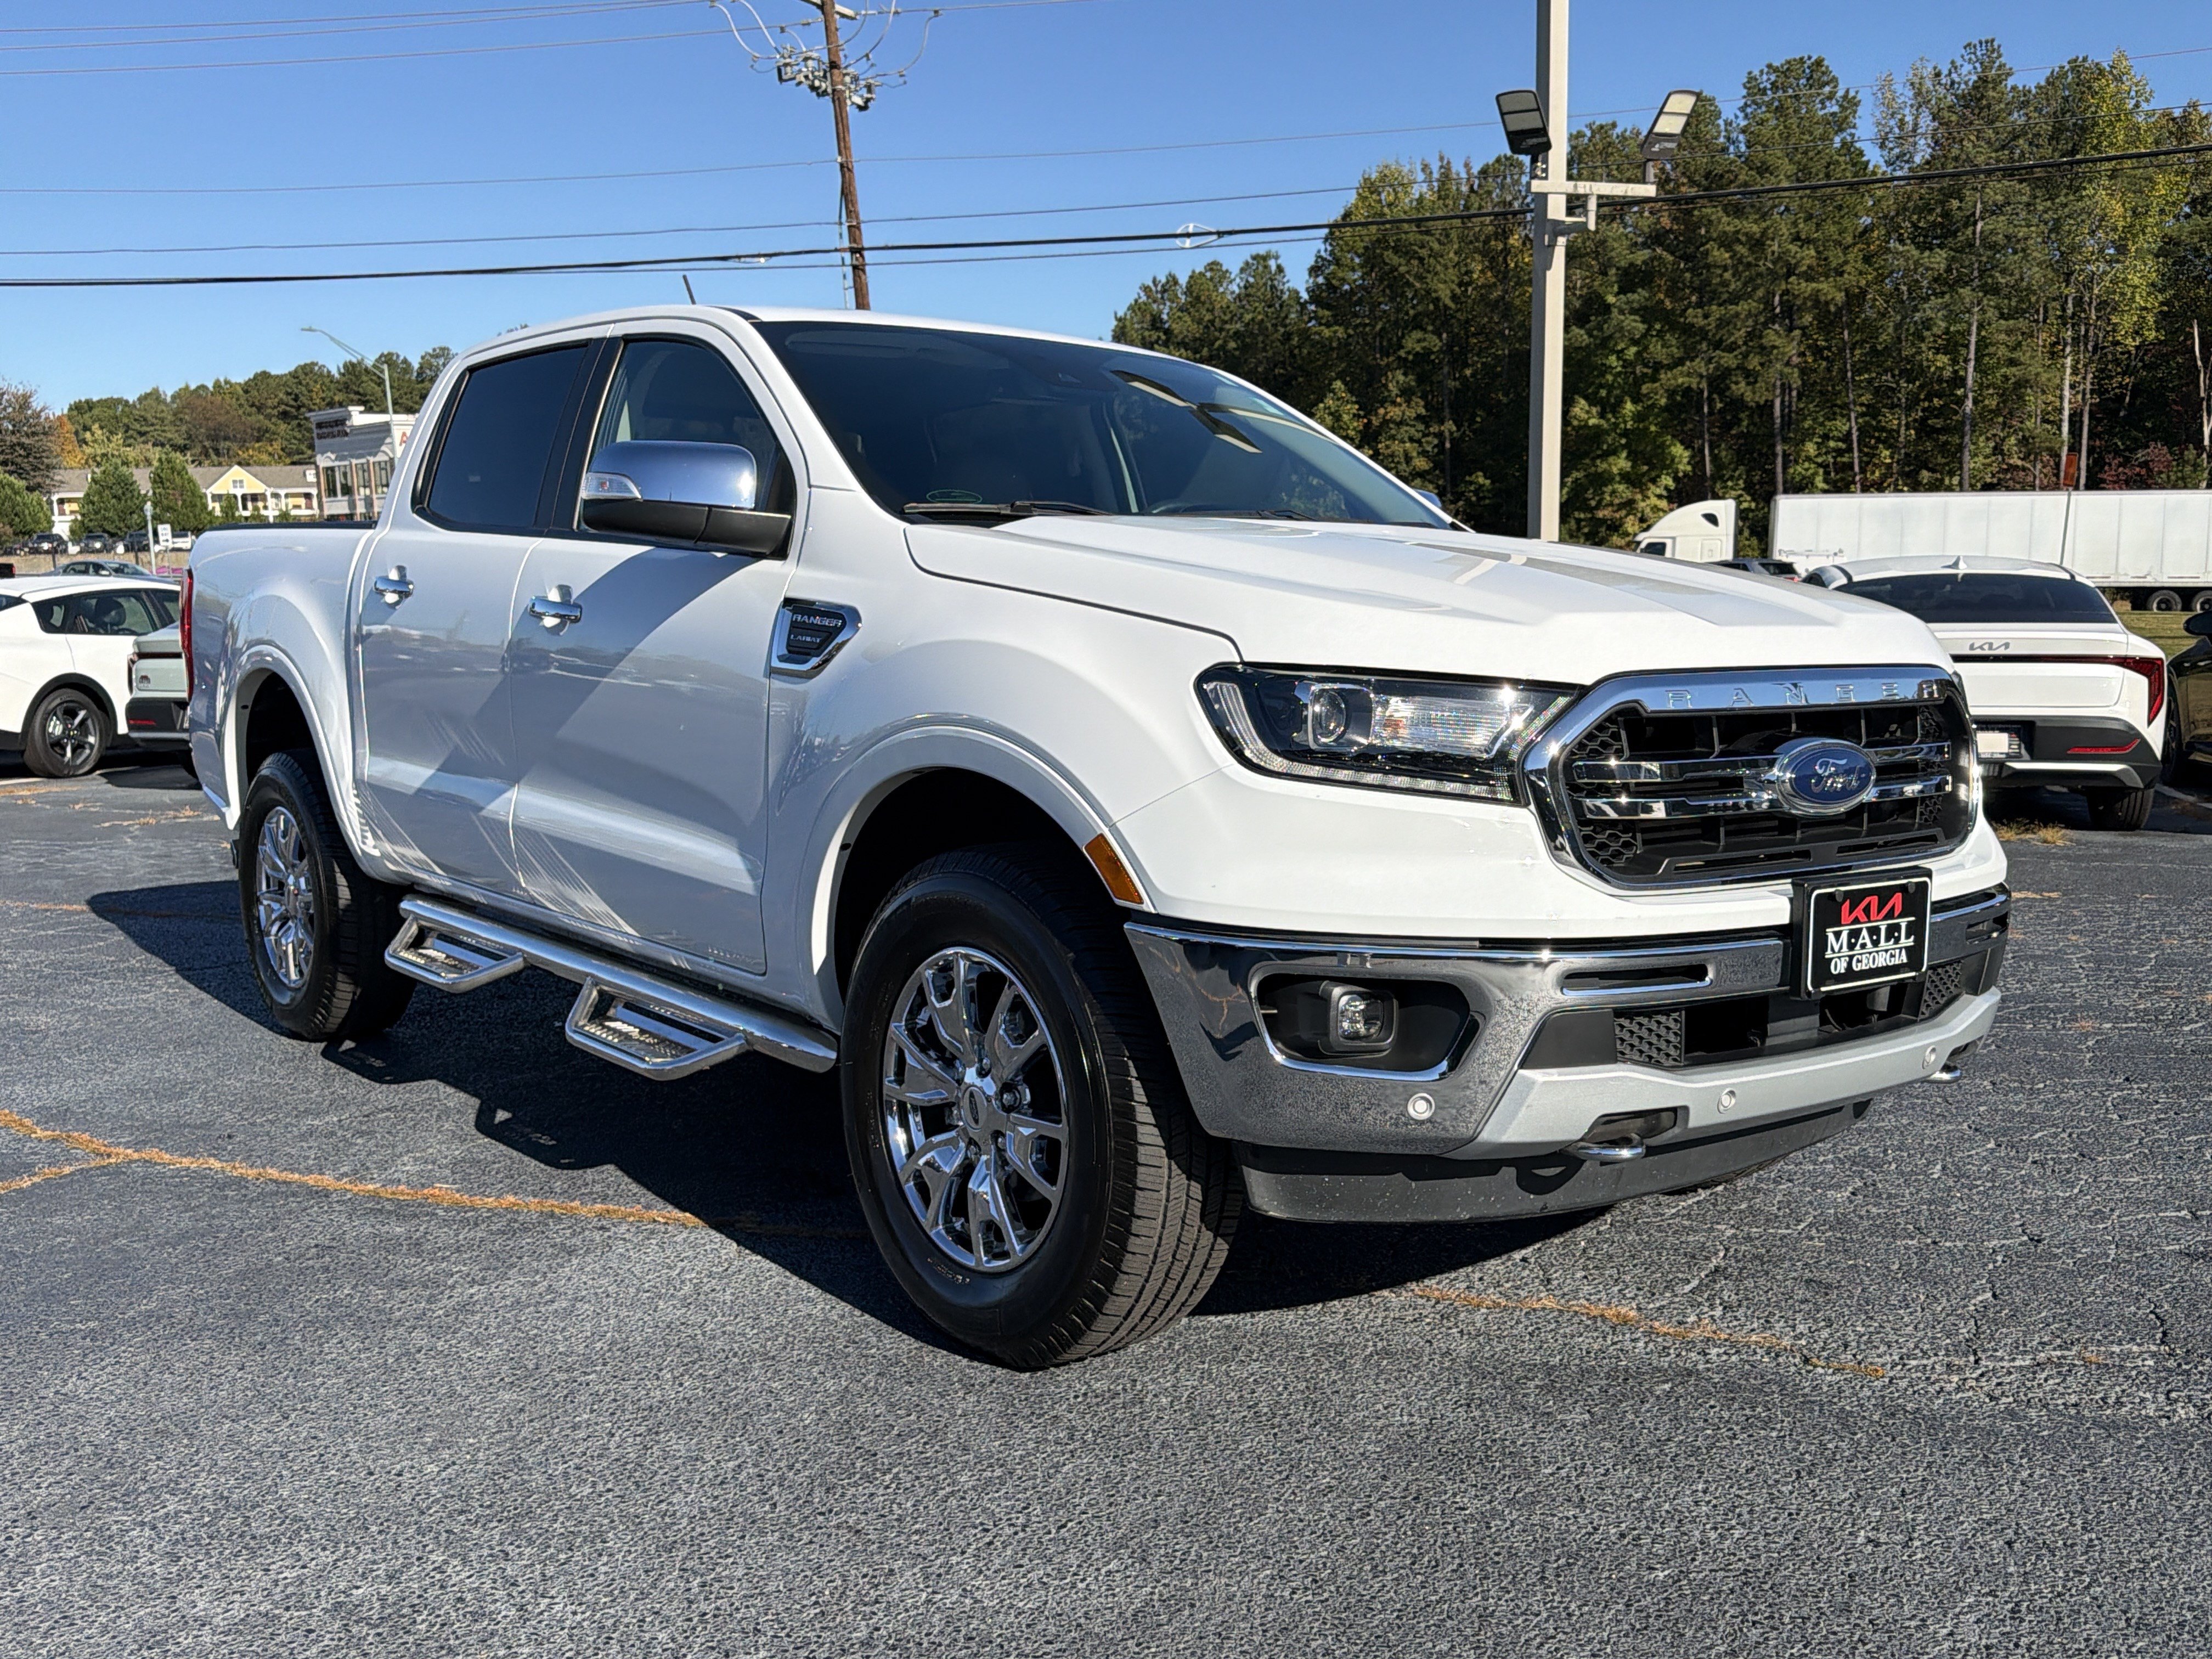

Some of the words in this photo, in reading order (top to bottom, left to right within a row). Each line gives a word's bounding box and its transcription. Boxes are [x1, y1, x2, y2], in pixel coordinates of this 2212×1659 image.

[793, 614, 843, 627] RANGER
[1665, 680, 1939, 709] RANGER
[1811, 758, 1860, 793] Ford
[1841, 892, 1903, 925] KIA
[1830, 956, 1849, 975] OF
[1852, 947, 1908, 971] GEORGIA
